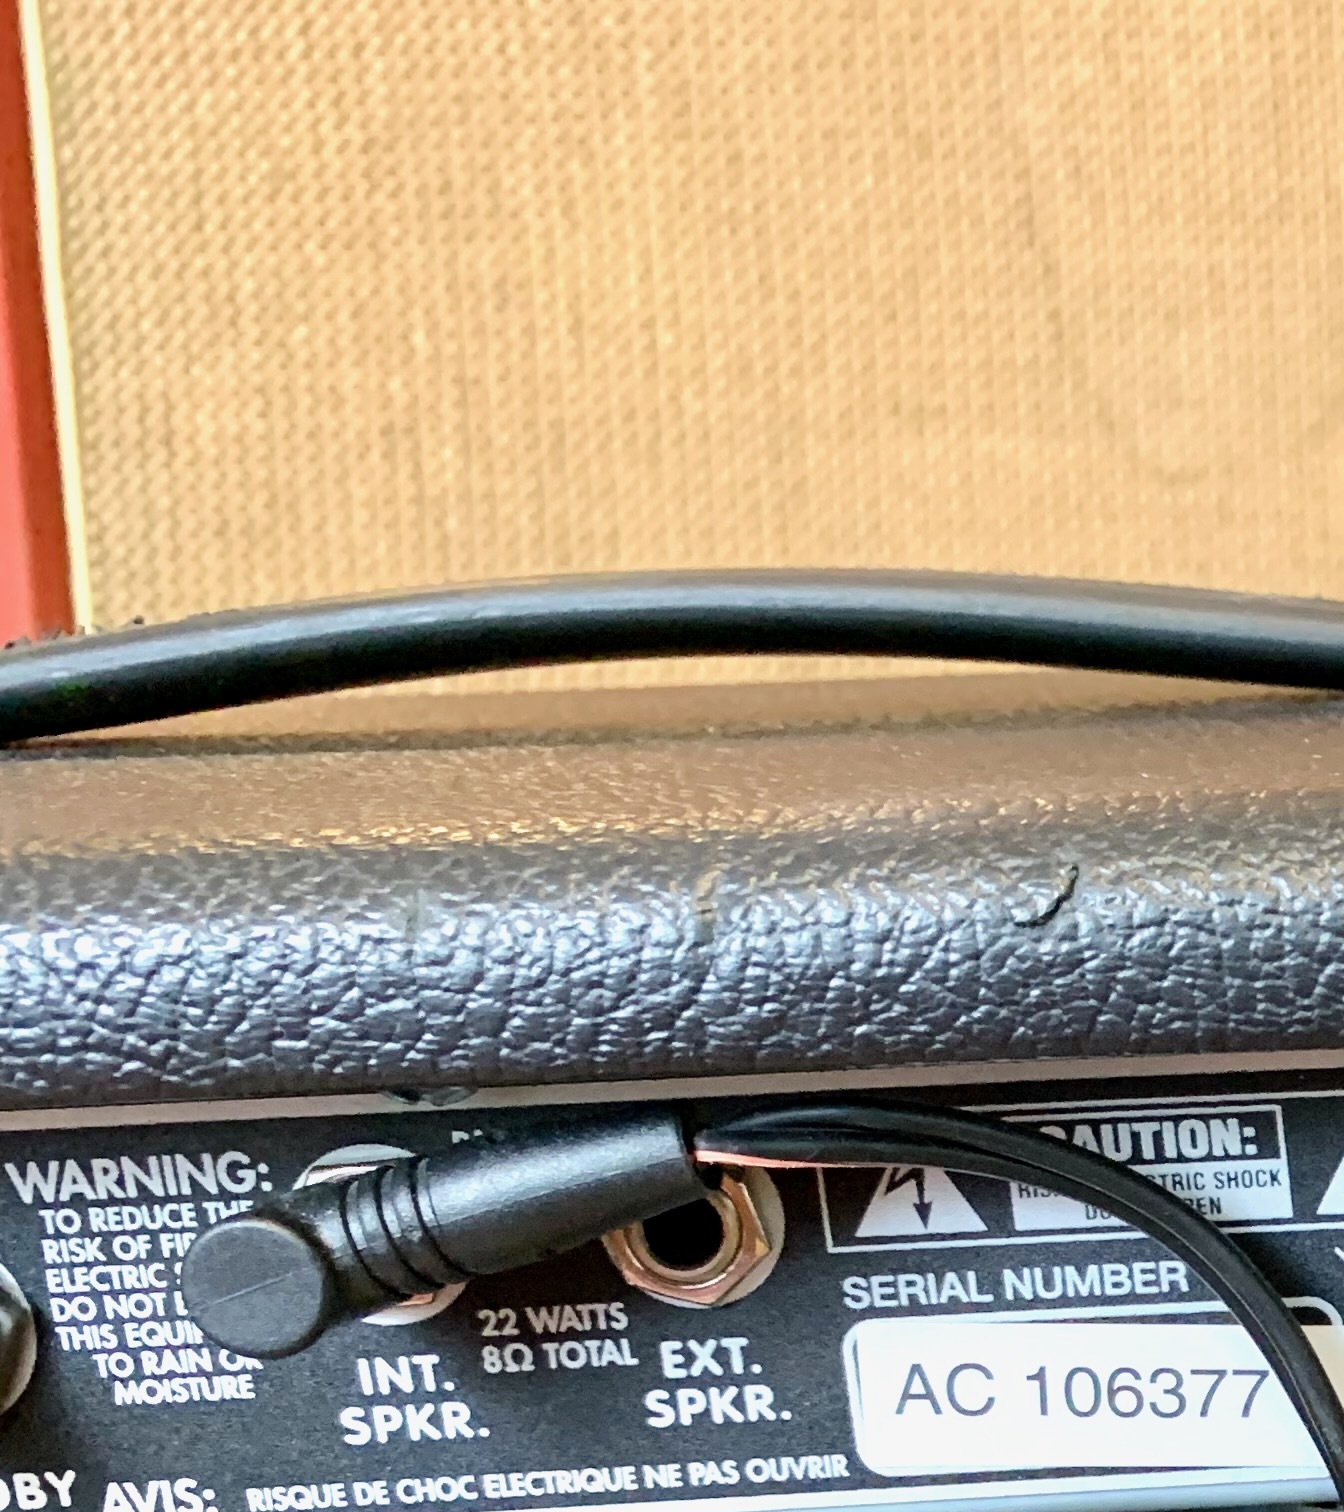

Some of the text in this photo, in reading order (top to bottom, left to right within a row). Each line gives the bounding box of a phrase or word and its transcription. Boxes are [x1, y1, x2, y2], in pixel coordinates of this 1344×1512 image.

[1039, 1117, 1258, 1162] AUTION:
[4, 1151, 272, 1204] WARNING:
[1215, 1168, 1283, 1190] SHOCK
[38, 1208, 82, 1234] TO
[88, 1203, 199, 1232] REDUCE
[41, 1236, 106, 1264] RISK
[112, 1234, 152, 1260] OF
[45, 1262, 168, 1294] ELECTRIC
[842, 1259, 1190, 1309] SERIAL NUMBER
[50, 1296, 98, 1322] DO
[102, 1292, 167, 1319] NOT
[478, 1302, 629, 1337] 22 WATTS
[54, 1323, 119, 1351] THIS
[543, 1338, 639, 1370] TOTAL
[92, 1351, 134, 1378] TO
[141, 1347, 213, 1376] RAIN
[356, 1354, 456, 1396] INT.
[660, 1337, 763, 1379] EXT.
[114, 1374, 256, 1405] MOISTURE
[643, 1384, 792, 1429] SPKR.
[894, 1362, 1271, 1419] AC 106377
[340, 1402, 490, 1446] SPKR.
[247, 1483, 348, 1512] RISQUE
[353, 1481, 390, 1507] DE
[396, 1475, 480, 1504] CHOC
[484, 1466, 639, 1499] ELECTRIQUE
[644, 1464, 683, 1488] NE
[688, 1459, 740, 1487] PAS
[746, 1454, 852, 1484] OUVRIR
